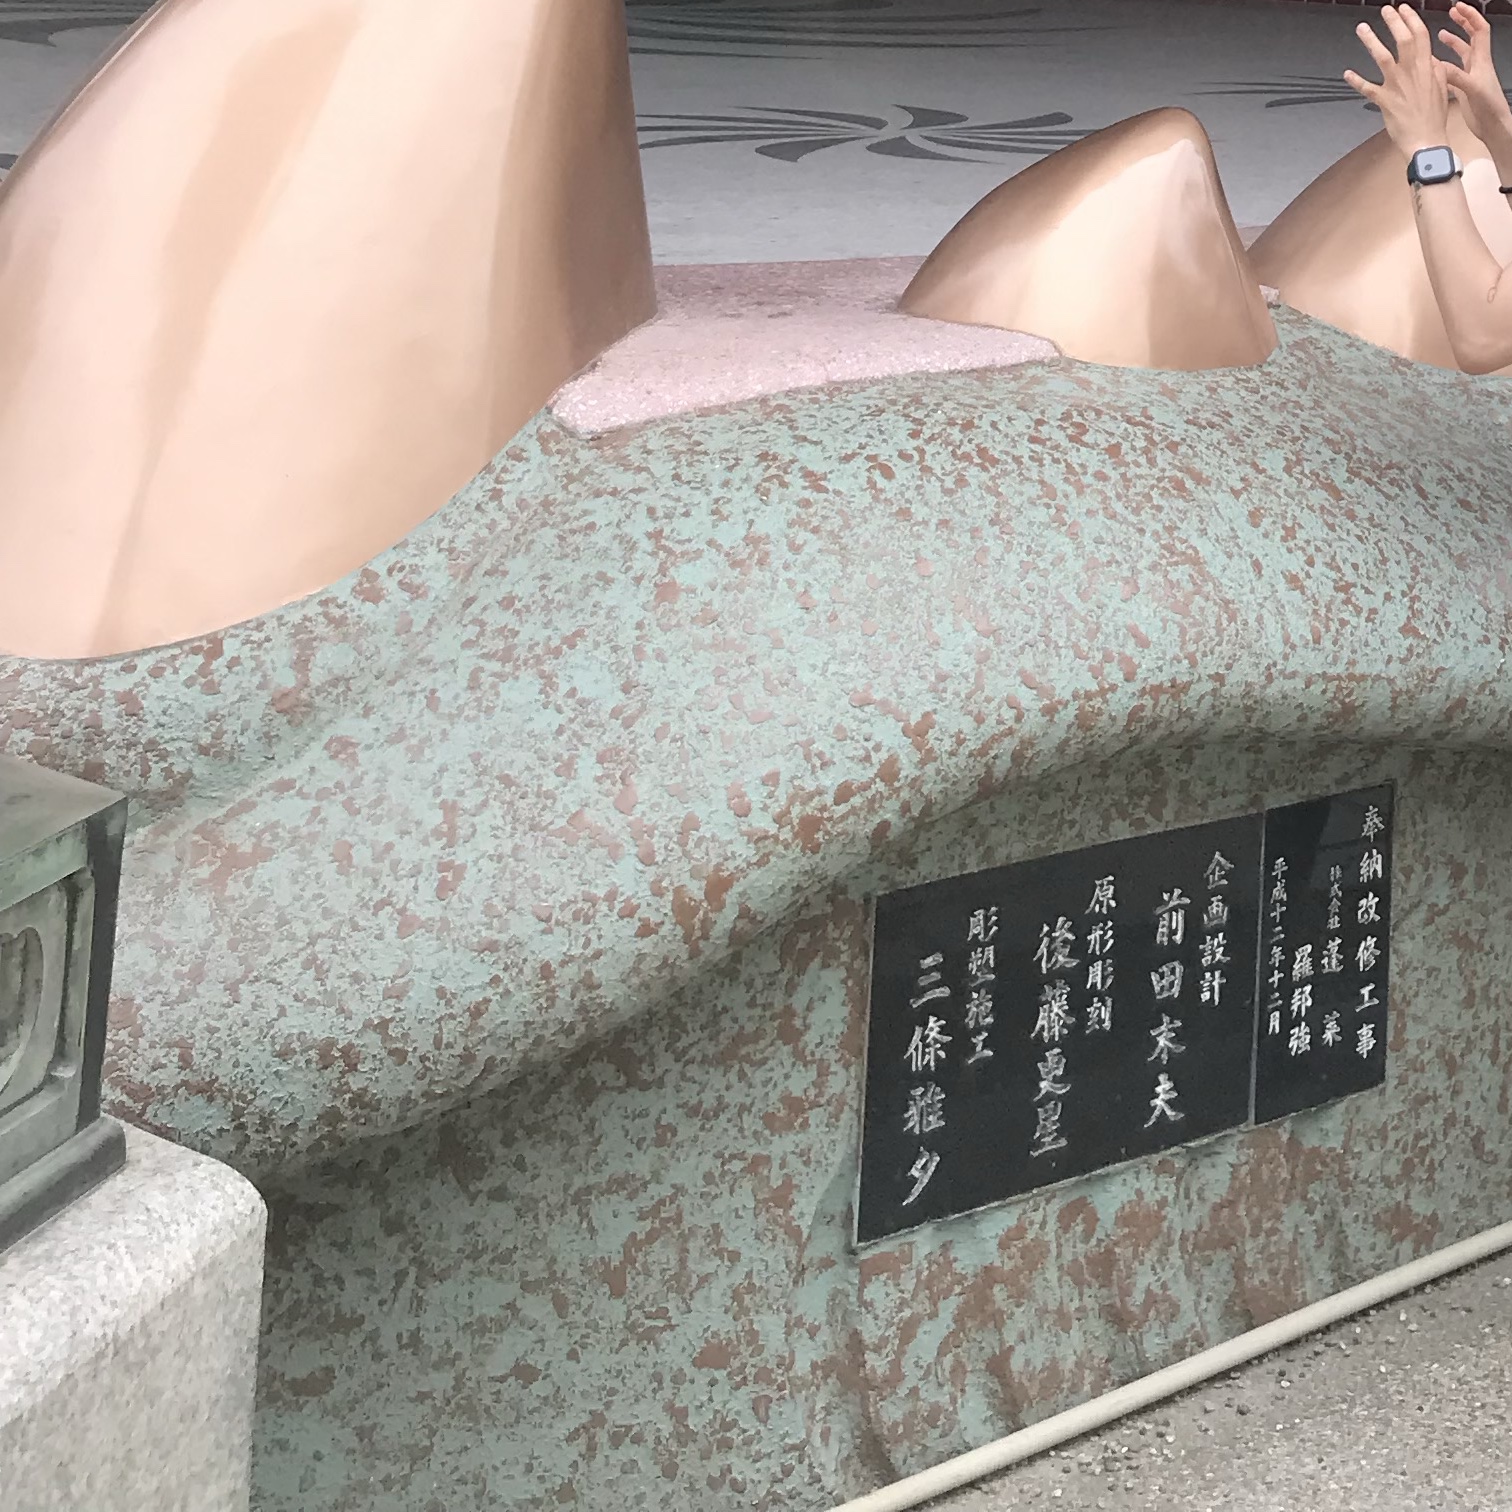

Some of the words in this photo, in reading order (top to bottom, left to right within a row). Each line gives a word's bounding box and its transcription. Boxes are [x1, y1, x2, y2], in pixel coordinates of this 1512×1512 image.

[1085, 875, 1116, 1034] 原形彫刻
[1199, 851, 1234, 1006] 企画設計
[1268, 857, 1288, 1035] 平成十二年十二月
[1289, 944, 1314, 1056] 羅邦強
[1355, 805, 1384, 1059] 奉納改修工事
